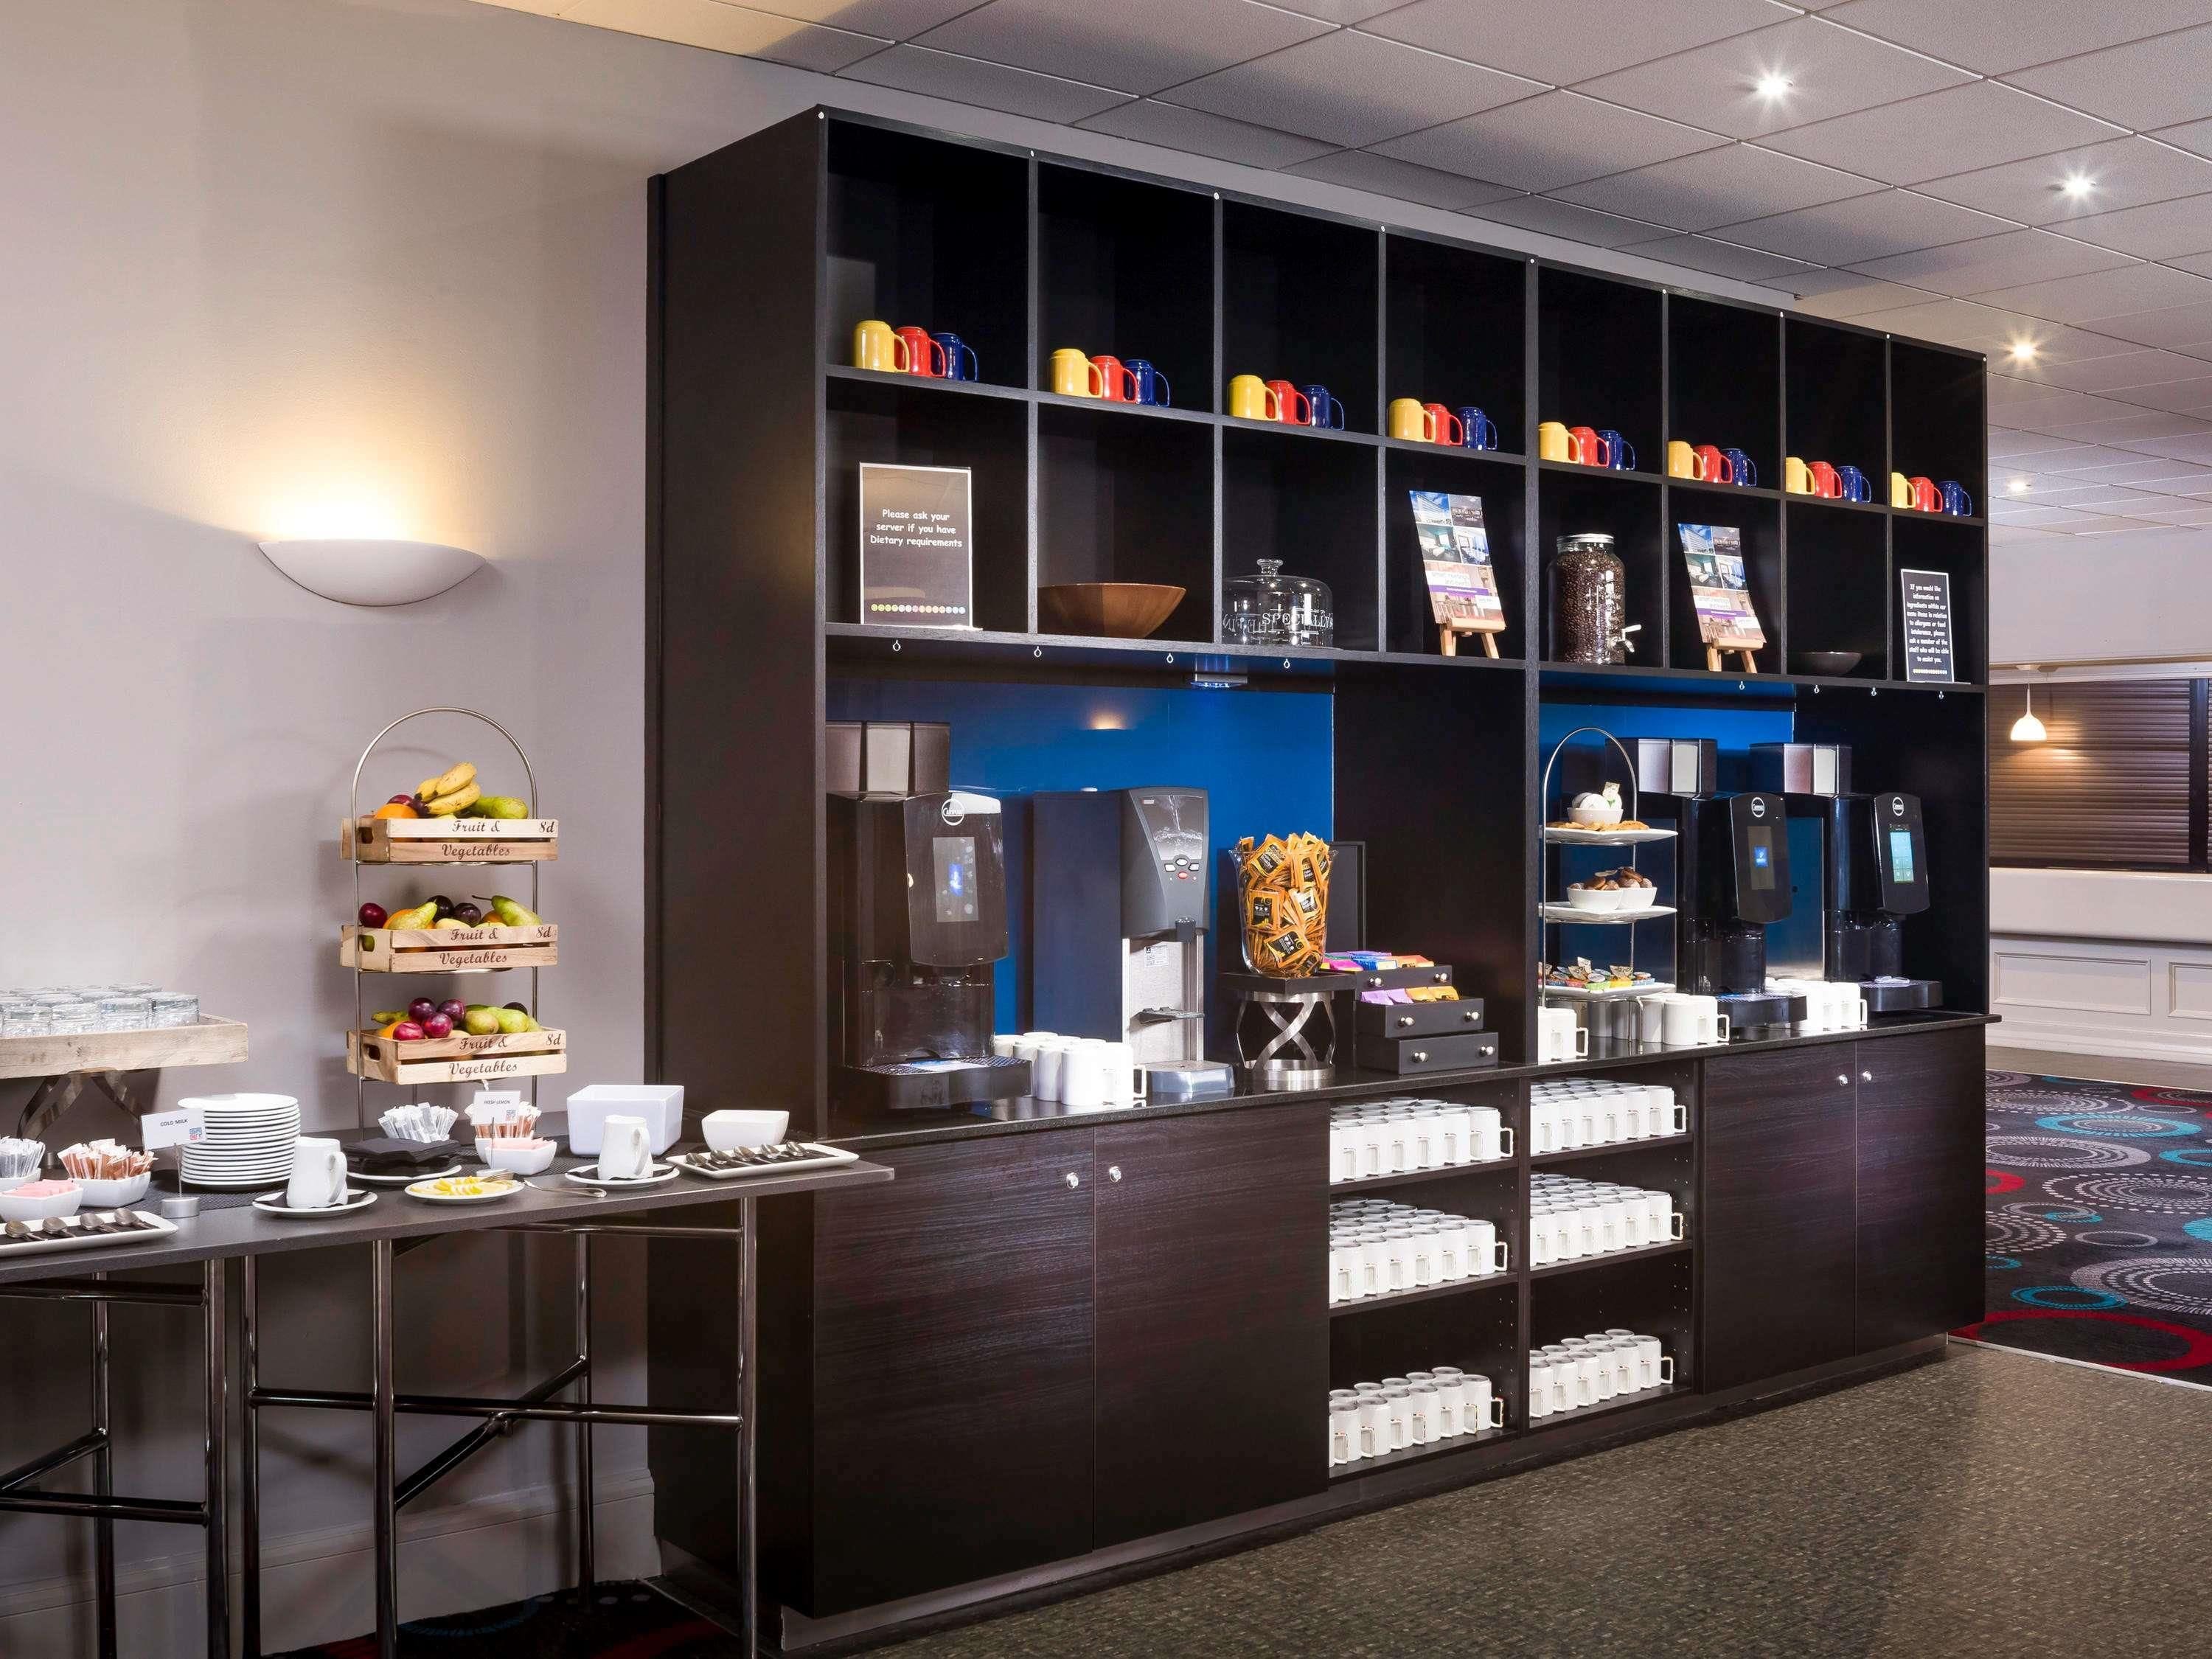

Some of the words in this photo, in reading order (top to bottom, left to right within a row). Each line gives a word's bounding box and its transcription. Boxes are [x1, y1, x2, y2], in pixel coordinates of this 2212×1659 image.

[882, 509, 910, 519] Please
[913, 511, 928, 520] ask
[931, 513, 950, 522] your
[876, 524, 904, 532] server
[908, 523, 915, 532] if
[918, 526, 933, 535] you
[936, 524, 956, 534] have
[870, 535, 903, 546] Dietary
[906, 538, 962, 547] requirements
[452, 820, 485, 832] Fruit
[491, 820, 501, 832] &
[442, 844, 511, 860] Vegetables
[451, 929, 484, 941] Fruit
[488, 928, 499, 939] &
[439, 952, 507, 968] Vegetables
[459, 1037, 494, 1051] Fruit
[498, 1035, 508, 1048] &
[449, 1060, 518, 1078] Vegetables
